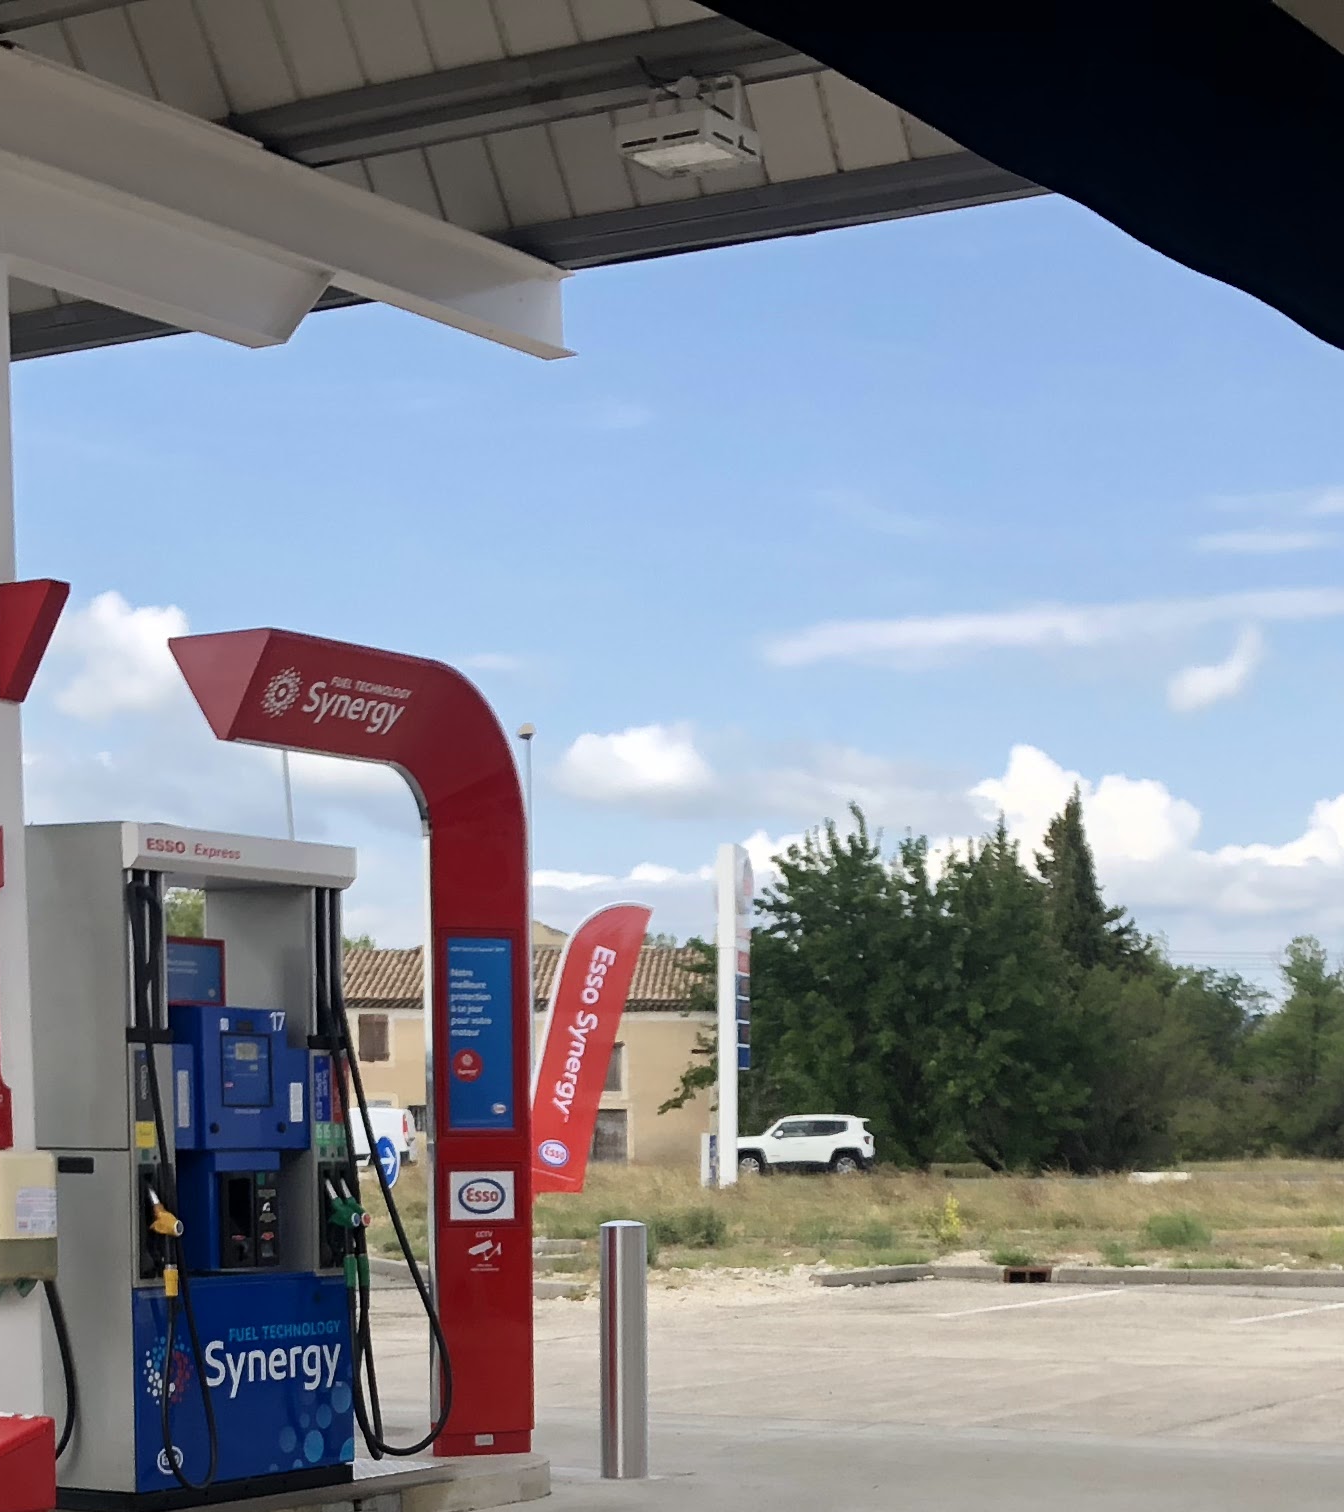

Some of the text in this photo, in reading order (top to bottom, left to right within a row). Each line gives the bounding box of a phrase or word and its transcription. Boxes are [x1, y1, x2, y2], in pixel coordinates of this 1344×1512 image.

[331, 676, 414, 699] FUEL TECHNOLOGY
[301, 681, 406, 735] Synergy
[146, 838, 241, 859] ESSO Express
[580, 944, 617, 1004] Esso
[269, 1011, 286, 1031] 17
[553, 1010, 599, 1115] Synergy
[466, 1187, 499, 1202] Esso
[228, 1320, 341, 1342] FUEL TECHNOLOGY
[205, 1340, 341, 1399] Synergy
